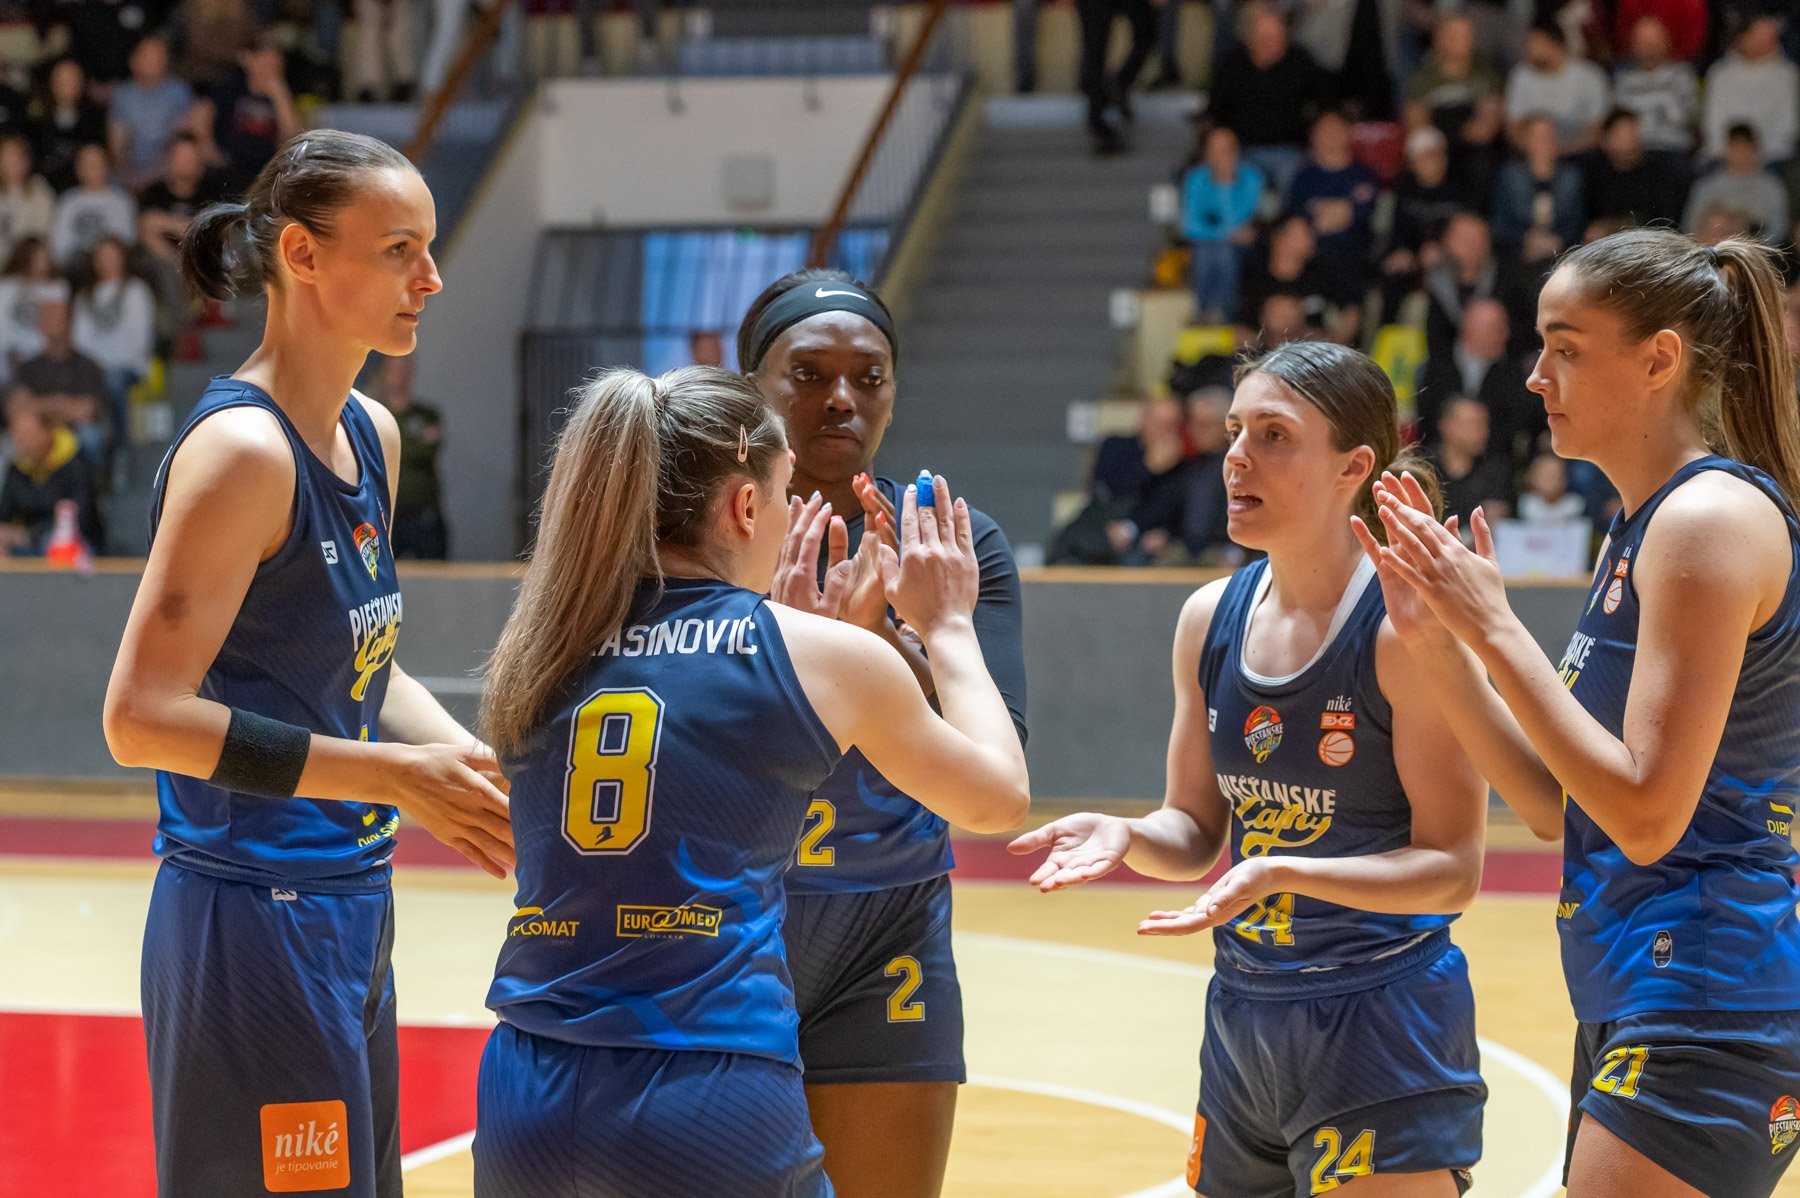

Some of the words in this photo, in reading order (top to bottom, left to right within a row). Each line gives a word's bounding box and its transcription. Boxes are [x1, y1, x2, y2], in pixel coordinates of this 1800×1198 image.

[591, 614, 758, 658] ASINOVIC
[1326, 695, 1351, 711] niké
[560, 686, 666, 856] 8
[797, 798, 836, 867] 2
[510, 920, 580, 937] LOMAT
[1235, 893, 1295, 946] 24
[884, 955, 926, 1023] 2
[1592, 1044, 1650, 1100] 21
[274, 1120, 339, 1158] niké
[1310, 1126, 1376, 1196] 24
[275, 1162, 286, 1175] je
[288, 1160, 338, 1173] tipovanie
